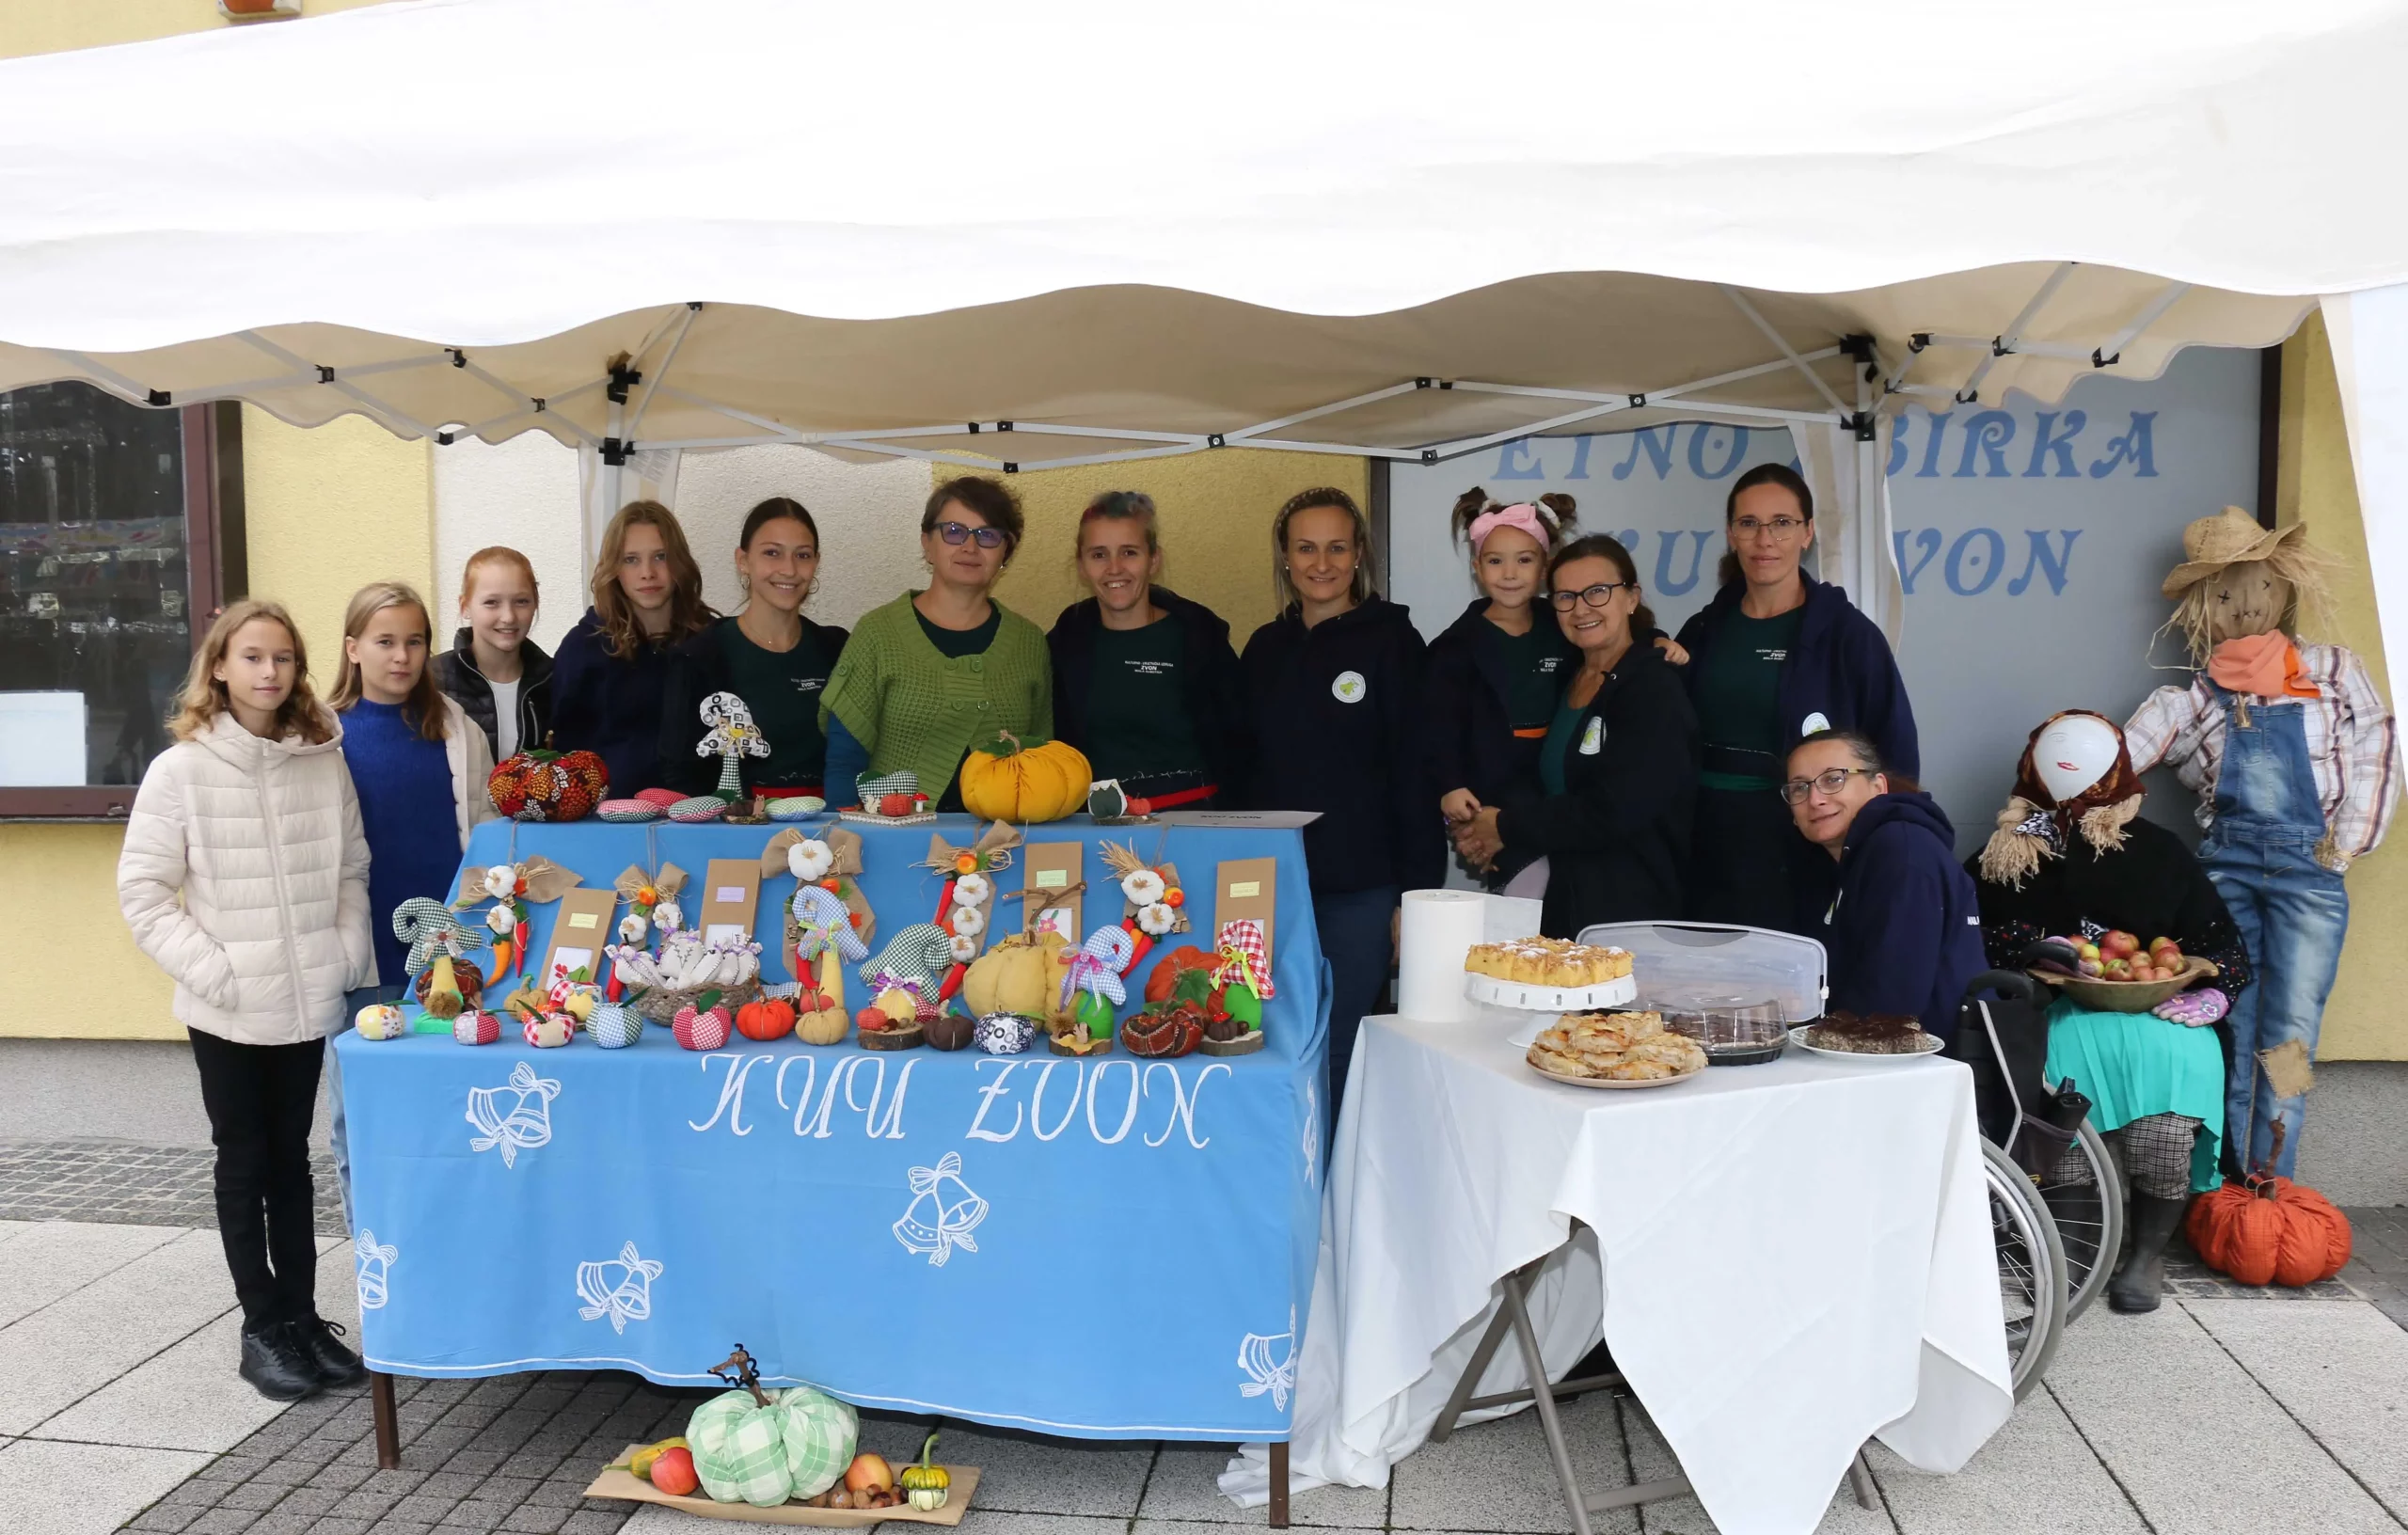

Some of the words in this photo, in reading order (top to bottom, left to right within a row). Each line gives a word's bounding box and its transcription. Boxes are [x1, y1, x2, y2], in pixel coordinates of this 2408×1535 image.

[1788, 409, 2160, 479] BIRKA
[1893, 528, 2083, 596] VON
[688, 1052, 922, 1139] KUU
